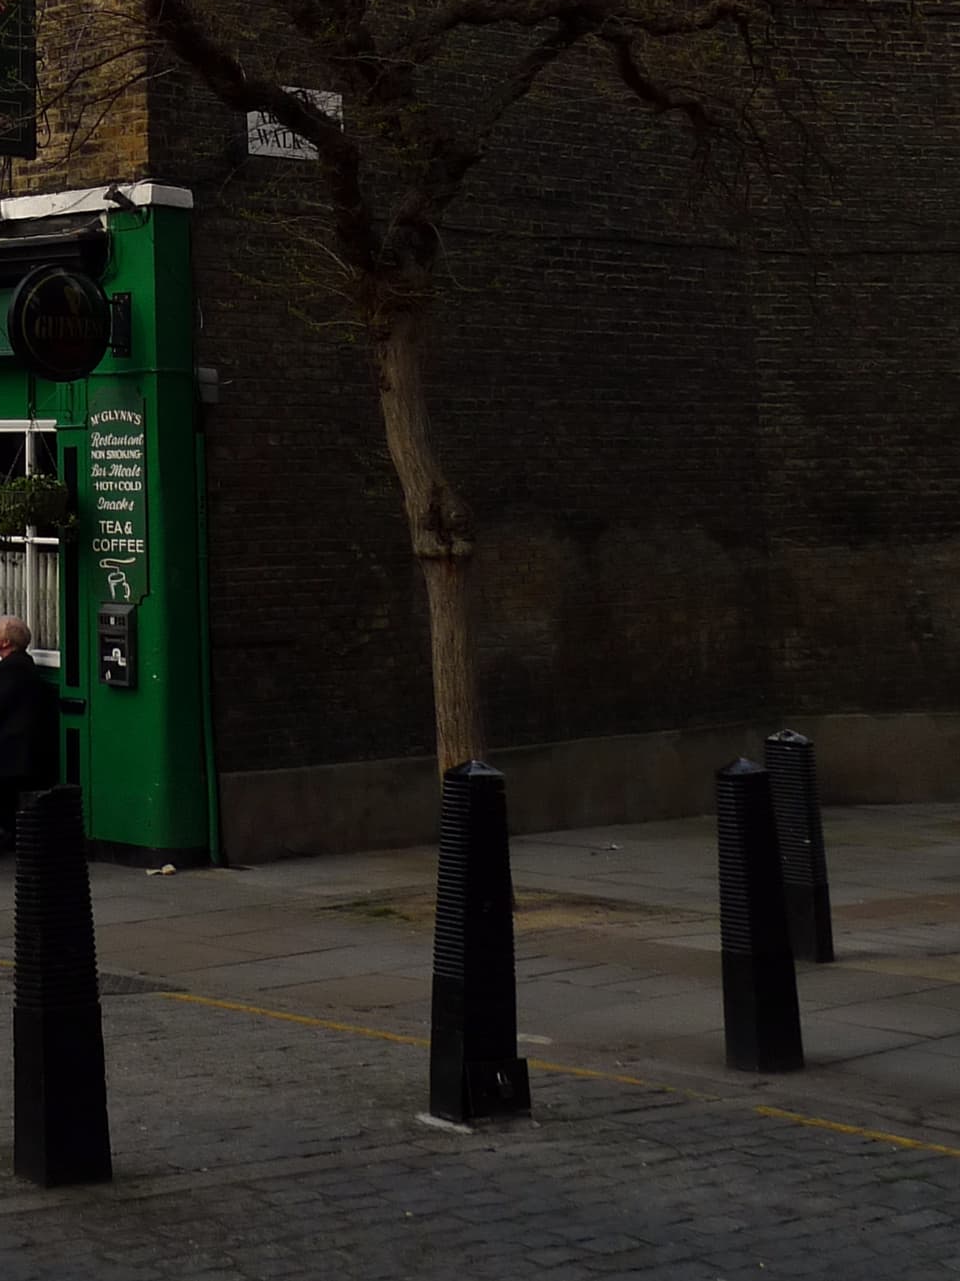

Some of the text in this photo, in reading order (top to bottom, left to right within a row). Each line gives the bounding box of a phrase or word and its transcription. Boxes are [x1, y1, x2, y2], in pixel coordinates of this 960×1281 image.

[90, 410, 142, 426] McGLYNN'S
[90, 432, 144, 448] Restaurant
[91, 450, 105, 460] NON
[91, 463, 141, 478] Bar Meals
[118, 480, 141, 491] COLD
[97, 496, 135, 511] Snacks
[99, 520, 132, 534] TEA &
[92, 538, 145, 553] COFFEE
